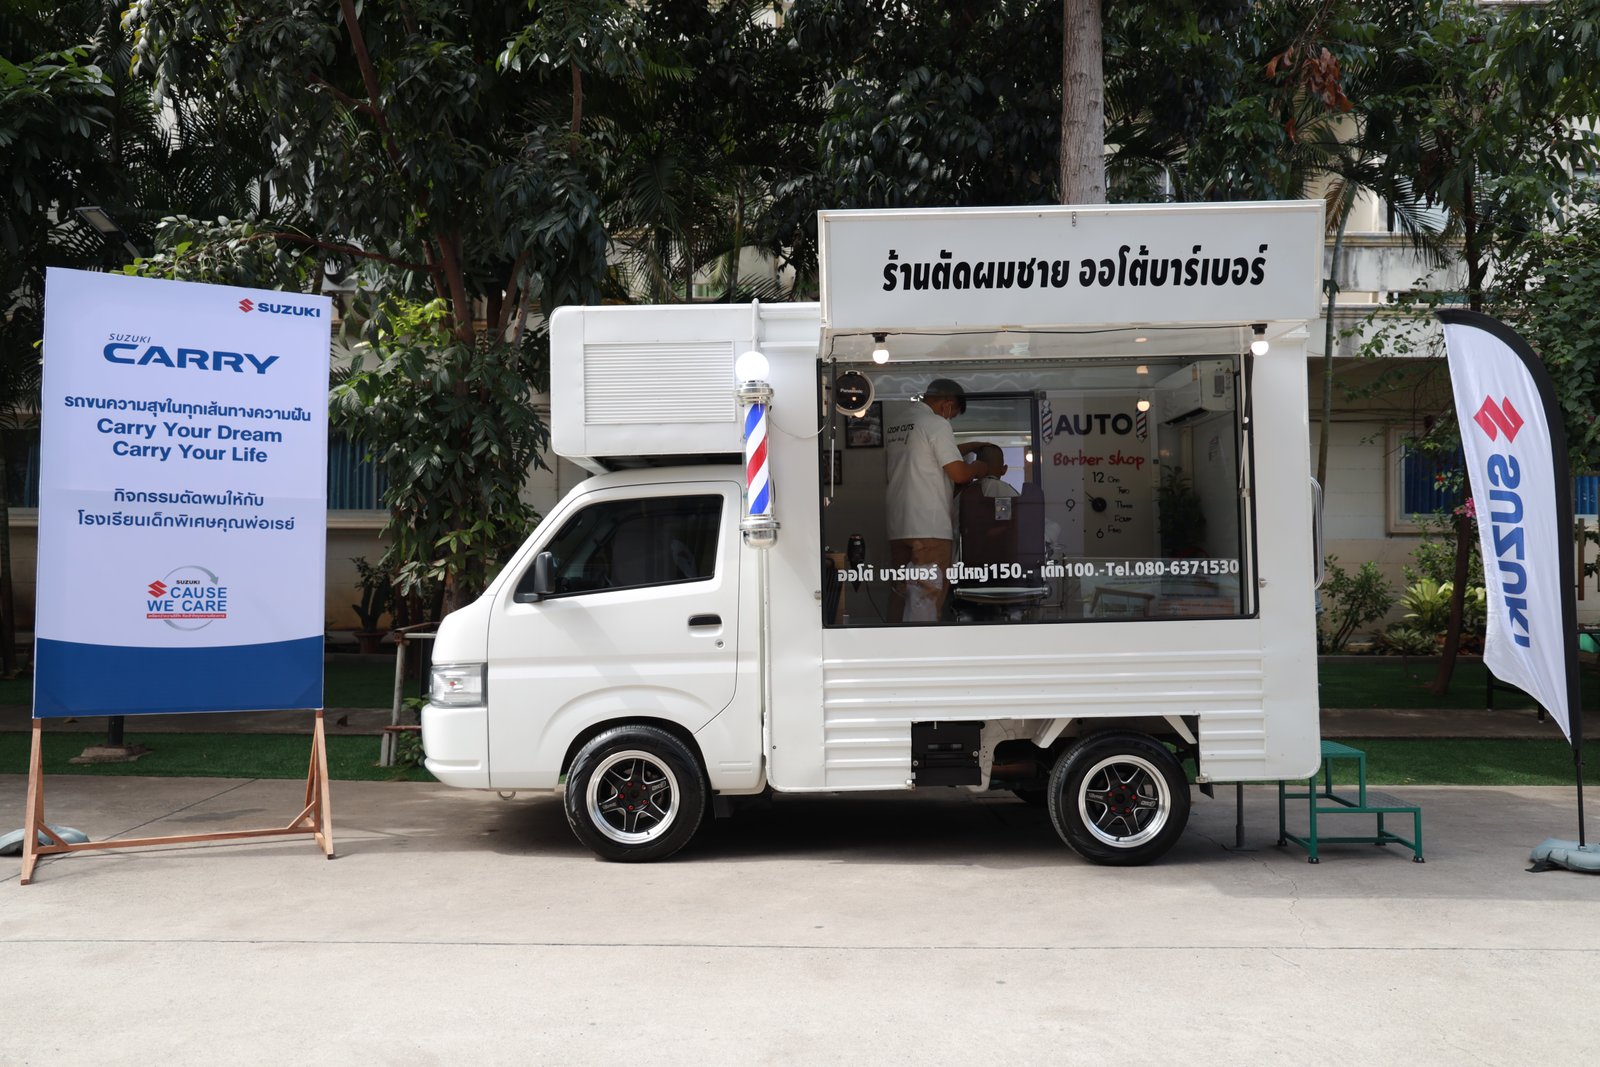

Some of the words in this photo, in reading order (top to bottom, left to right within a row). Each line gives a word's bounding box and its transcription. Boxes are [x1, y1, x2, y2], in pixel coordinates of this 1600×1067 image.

[883, 249, 1070, 291] ร้านตัดผมชาย
[1079, 244, 1268, 287] ออโต้บาร์เบอร์
[257, 302, 321, 318] SUZUKI
[109, 333, 151, 343] SUZUKI
[103, 342, 280, 375] CARRY
[64, 395, 312, 422] รถขนความสุขในทุกเส้นทางความฝัน
[97, 418, 157, 439] Carry
[163, 422, 212, 439] Your
[217, 425, 282, 442] Dream
[1054, 413, 1133, 436] AUTO
[112, 441, 172, 462] Carry
[178, 444, 226, 461] Your
[232, 447, 268, 463] Life
[1053, 450, 1103, 467] Barber
[1108, 450, 1145, 470] shop
[1092, 471, 1105, 483] 12
[114, 488, 264, 506] กิจกรรมตัดผมให้กับ
[1065, 499, 1075, 512] 9
[78, 510, 295, 533] โรงเรียนเด็กพิเศษคุณพ่อเรย์
[1096, 528, 1104, 539] 6
[837, 563, 874, 582] ออโต้
[880, 564, 938, 582] บาร์เบอร์
[170, 587, 227, 599] CAUSE
[147, 600, 174, 612] WE
[182, 600, 227, 612] CARE
